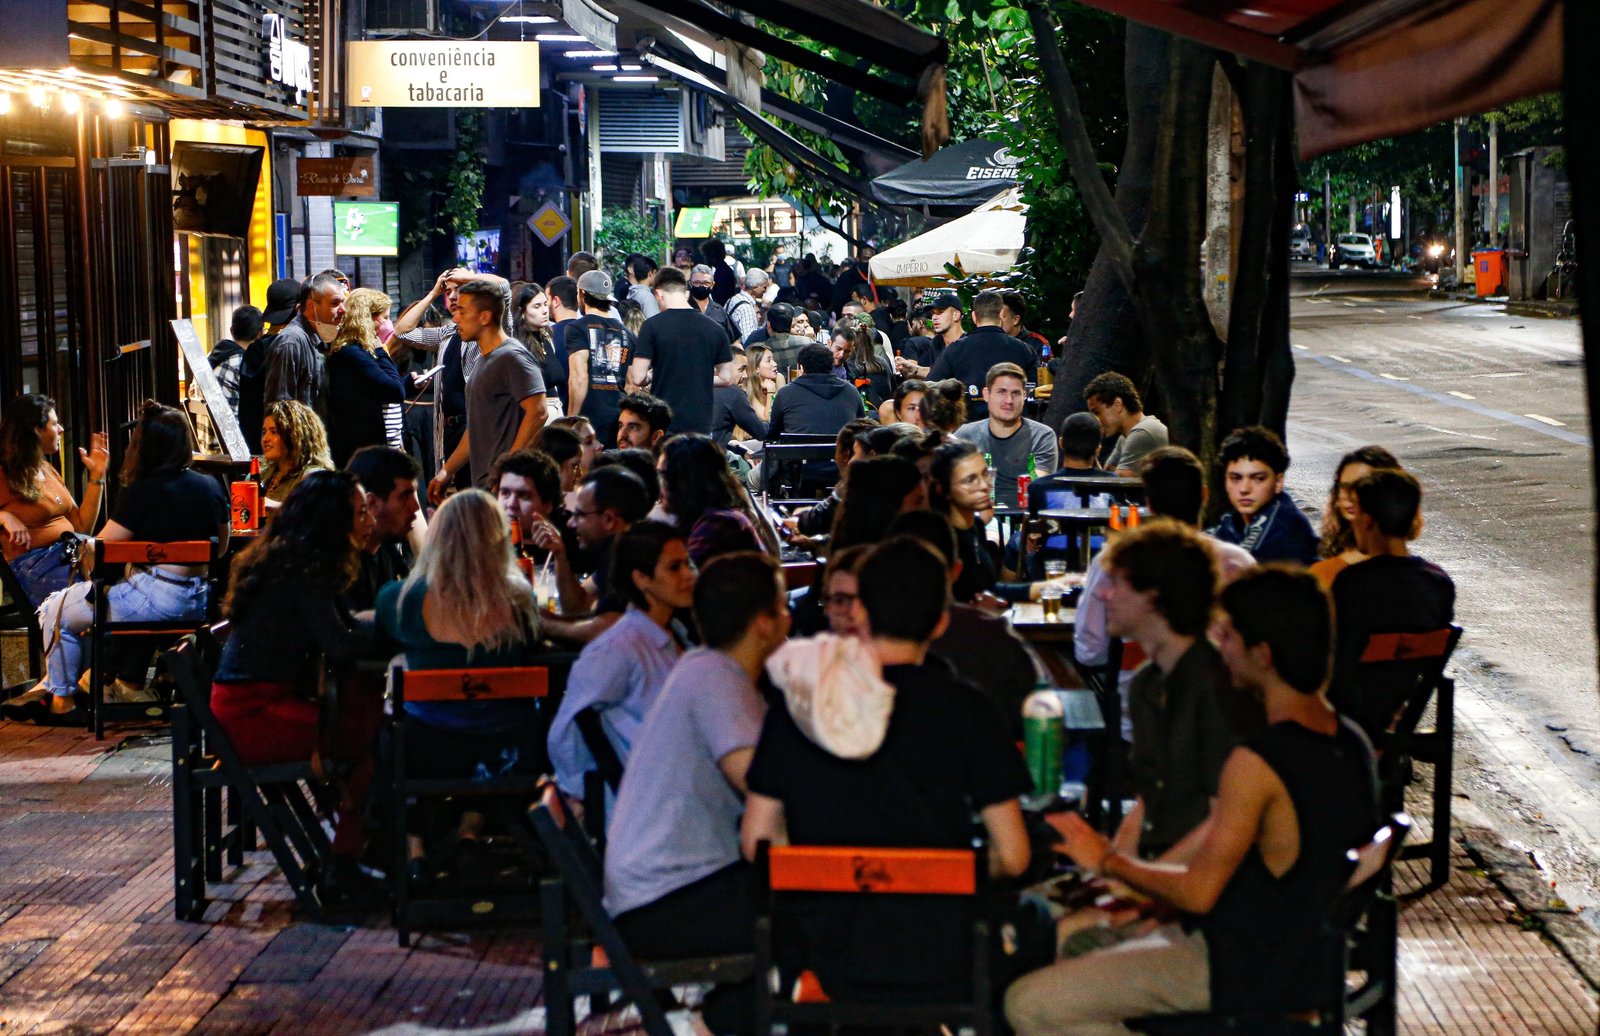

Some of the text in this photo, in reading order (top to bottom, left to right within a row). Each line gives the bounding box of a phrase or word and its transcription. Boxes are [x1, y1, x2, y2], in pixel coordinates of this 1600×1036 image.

[390, 48, 495, 66] conveniência
[439, 70, 448, 84] e
[408, 82, 484, 102] tabacaria
